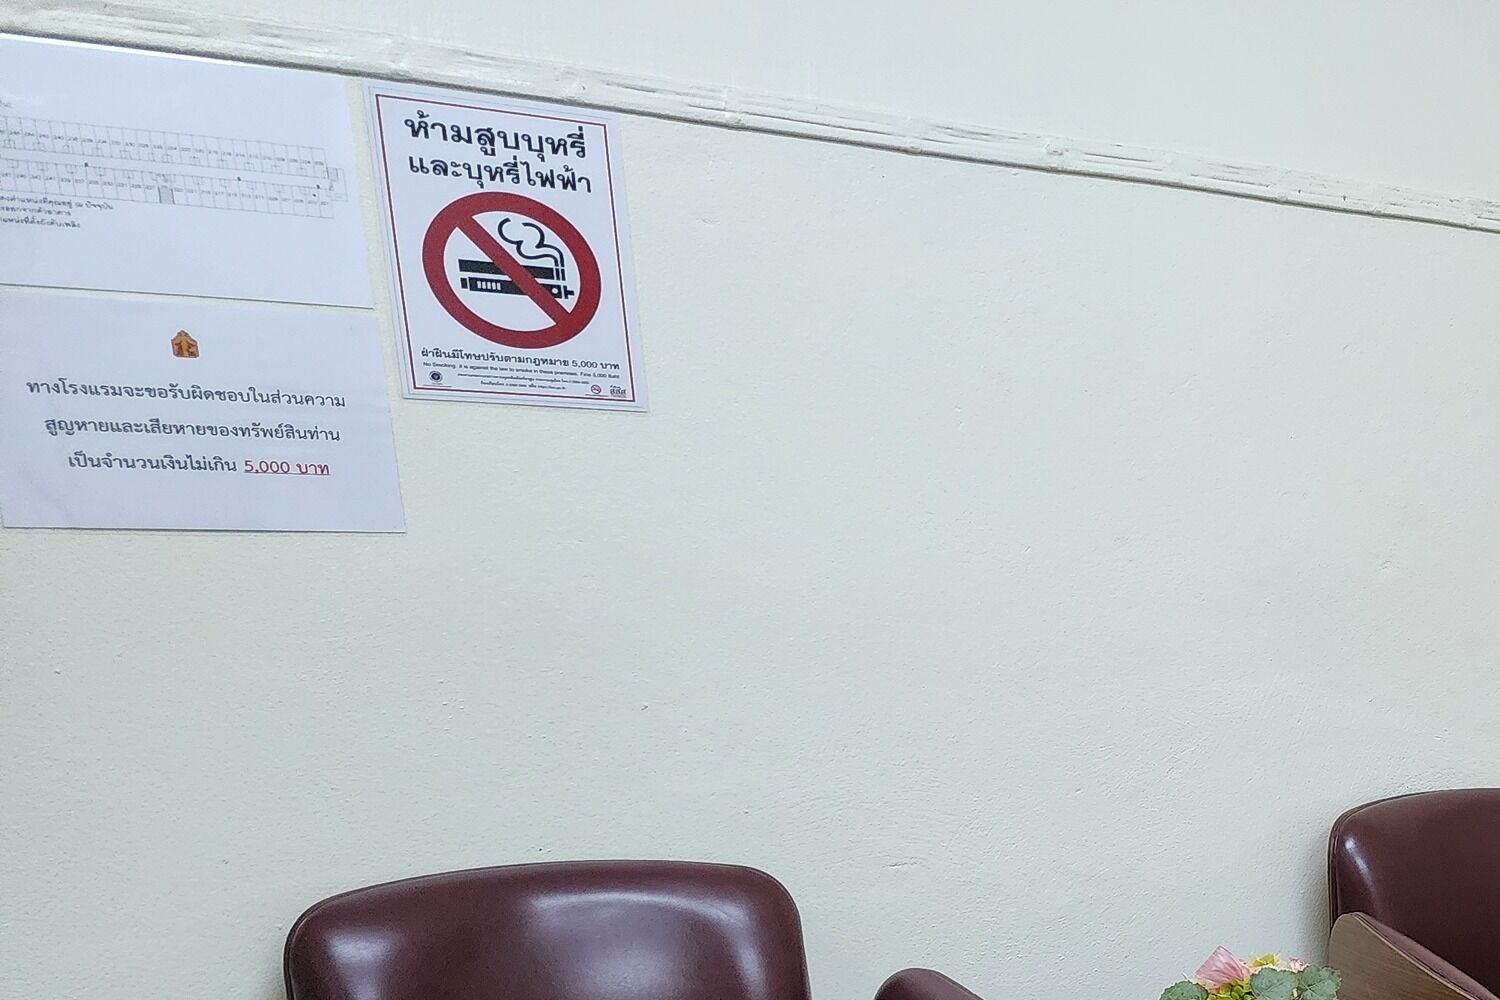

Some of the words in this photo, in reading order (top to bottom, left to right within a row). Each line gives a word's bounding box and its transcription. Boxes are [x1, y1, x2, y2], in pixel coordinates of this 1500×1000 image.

[404, 110, 586, 162] ห้ามสูบบุหรี่
[409, 155, 592, 193] และบุหรี่ไฟฟ้า
[421, 347, 569, 366] ฝ่าฝืนมีโทษปรับตามกฎหมาย
[572, 360, 598, 369] 5,000
[600, 362, 620, 370] บาท
[26, 377, 346, 407] ทางโรงแรมจะขอรับผิดชอบในส่วนความ
[45, 417, 341, 442] สูญหายและเสียหายของทรัพย์สินท่าน
[68, 450, 237, 472] เป็นจำนวนเงินไม่เกิน
[244, 460, 290, 474] 5,000
[296, 462, 330, 475] บาท
